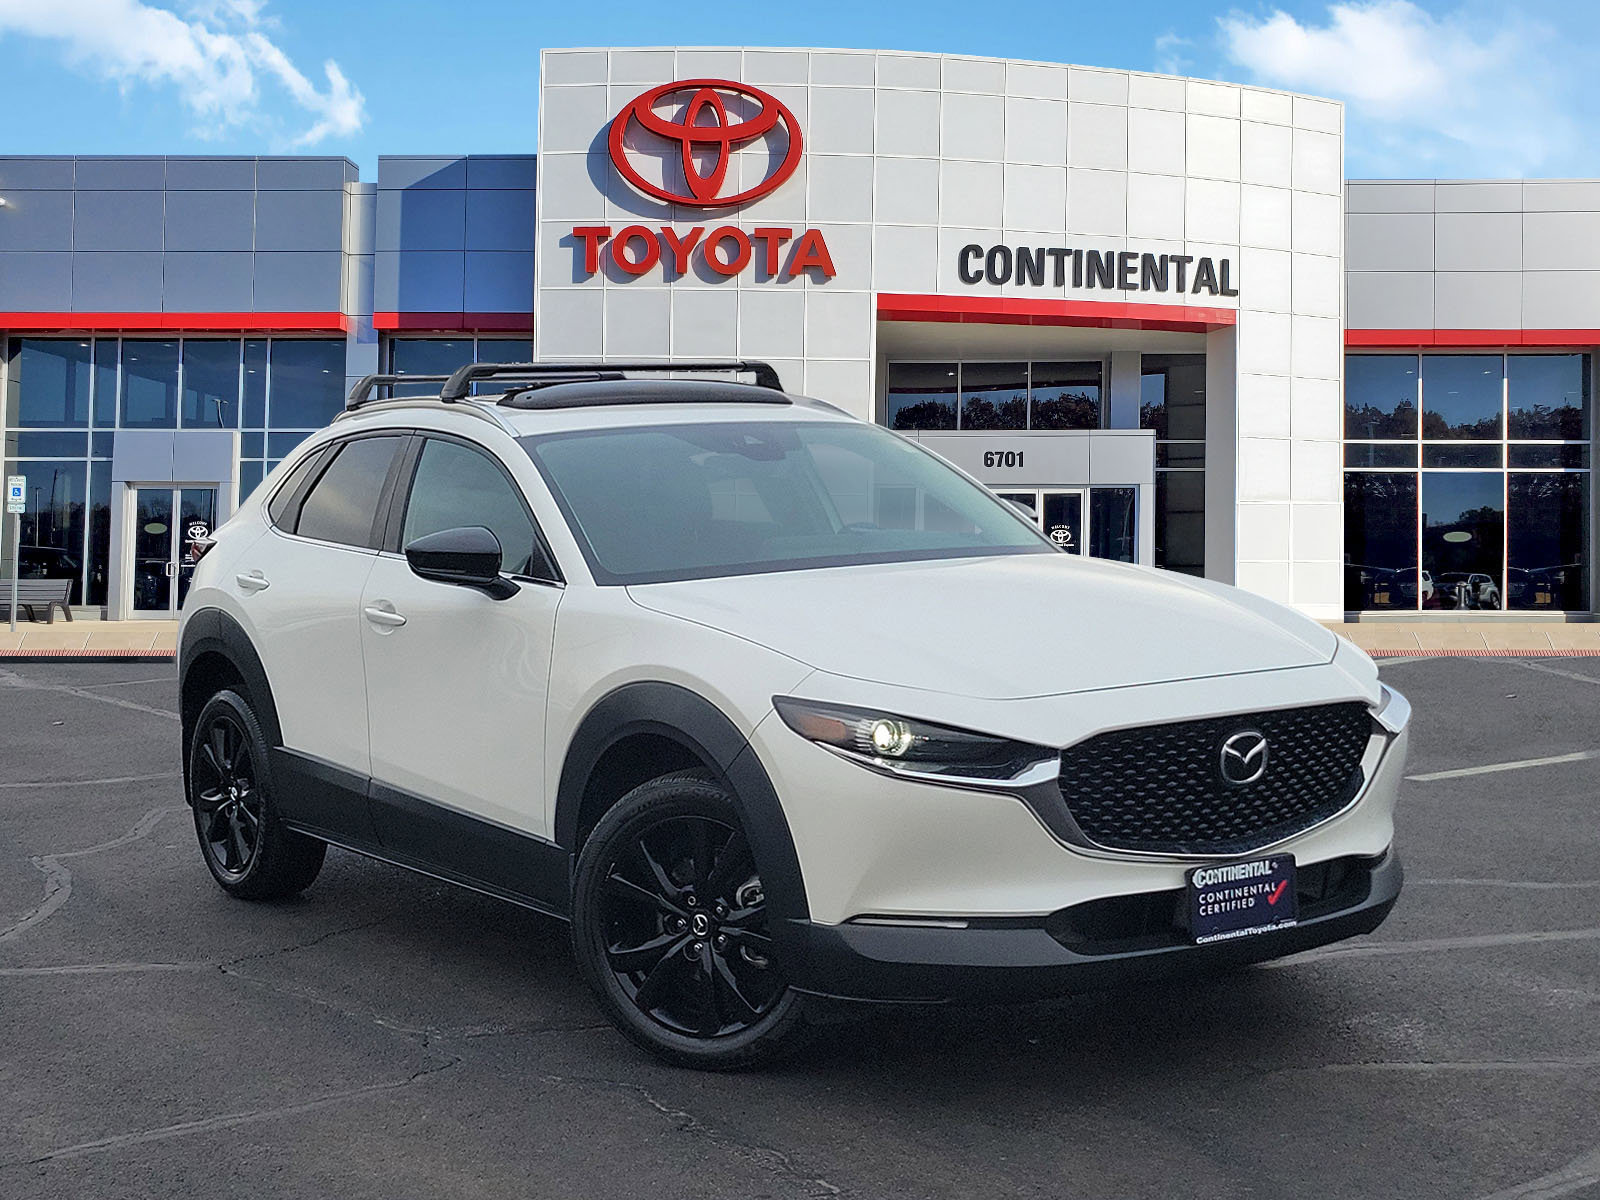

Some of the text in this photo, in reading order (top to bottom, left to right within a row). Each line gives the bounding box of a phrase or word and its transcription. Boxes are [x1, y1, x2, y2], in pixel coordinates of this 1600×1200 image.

[573, 225, 836, 277] TOYOTA
[959, 244, 1239, 297] CONTINENTAL
[984, 451, 1024, 468] 6701
[1192, 860, 1272, 888] CONTINENTAL
[1199, 881, 1277, 904] CONTINENTAL
[1199, 897, 1255, 916] CERTIFIED
[1196, 920, 1297, 944] ContinentalToyota.com
